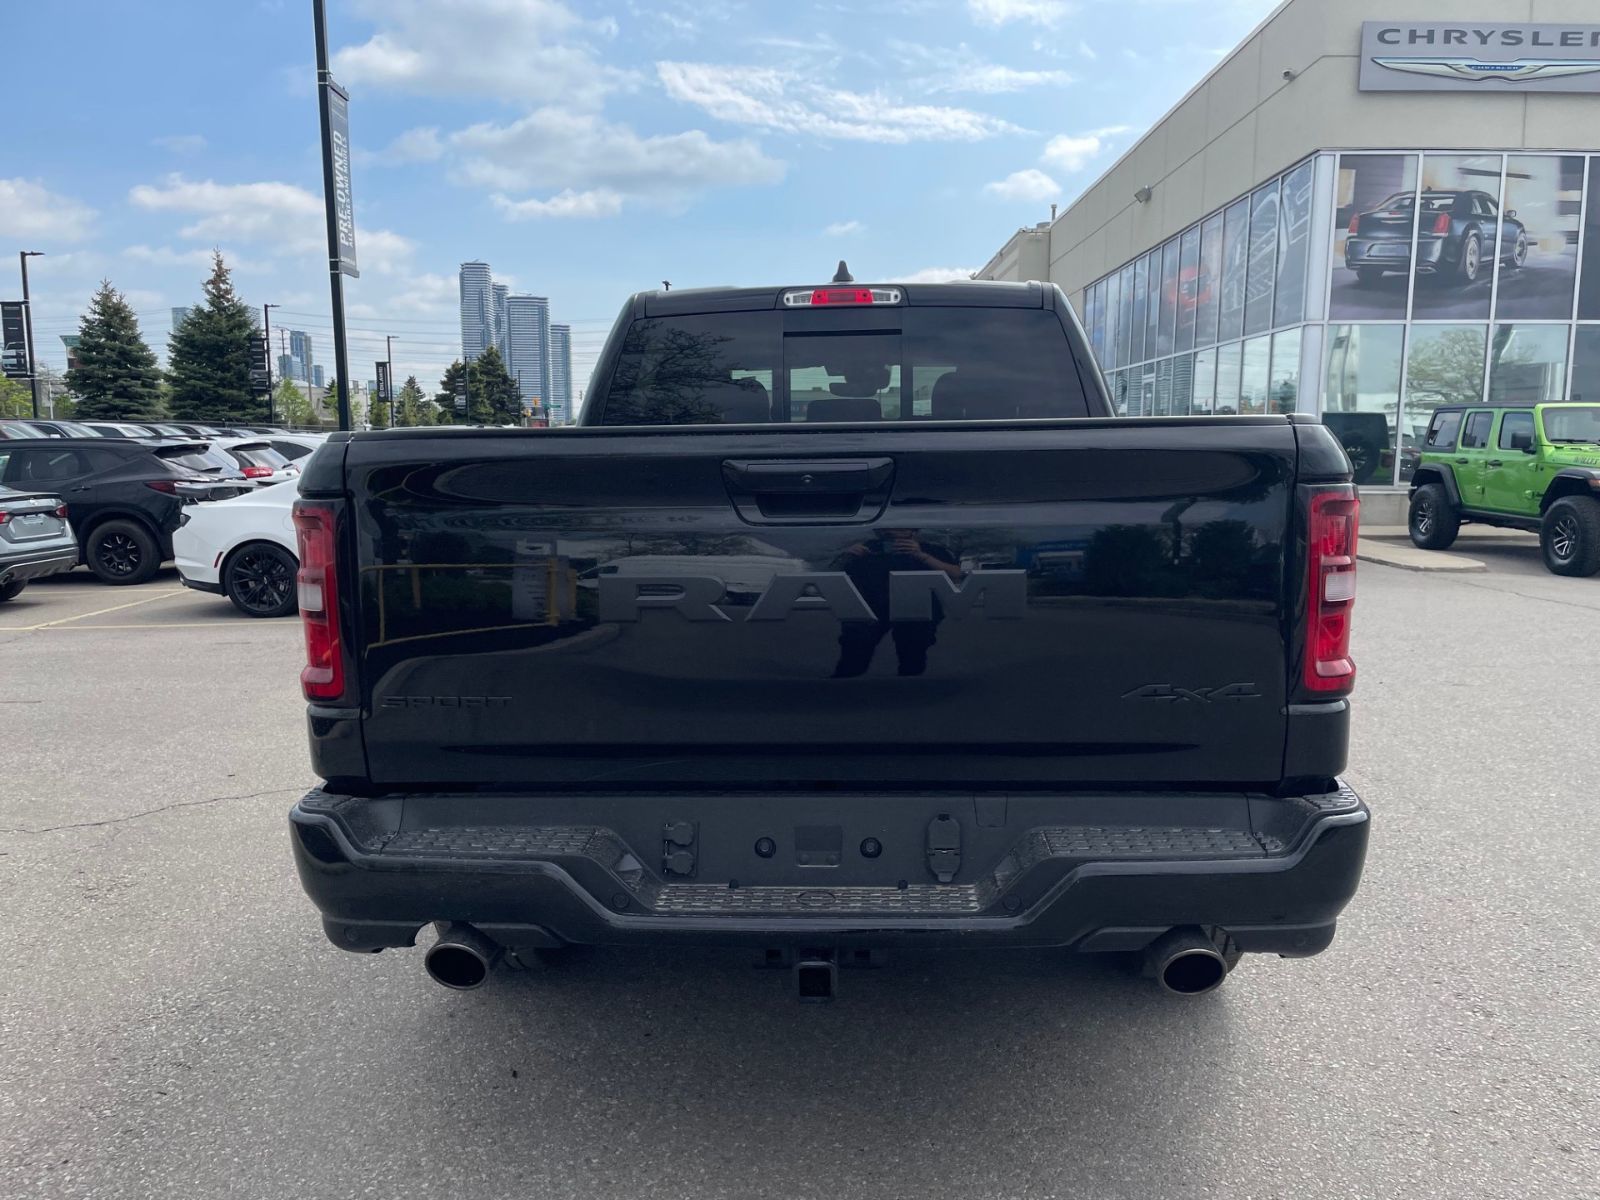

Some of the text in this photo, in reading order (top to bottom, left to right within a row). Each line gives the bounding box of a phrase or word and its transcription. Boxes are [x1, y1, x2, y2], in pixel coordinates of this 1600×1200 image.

[333, 130, 349, 246] PRE-OWNED
[599, 569, 1028, 622] RAM
[380, 695, 513, 708] SPORT
